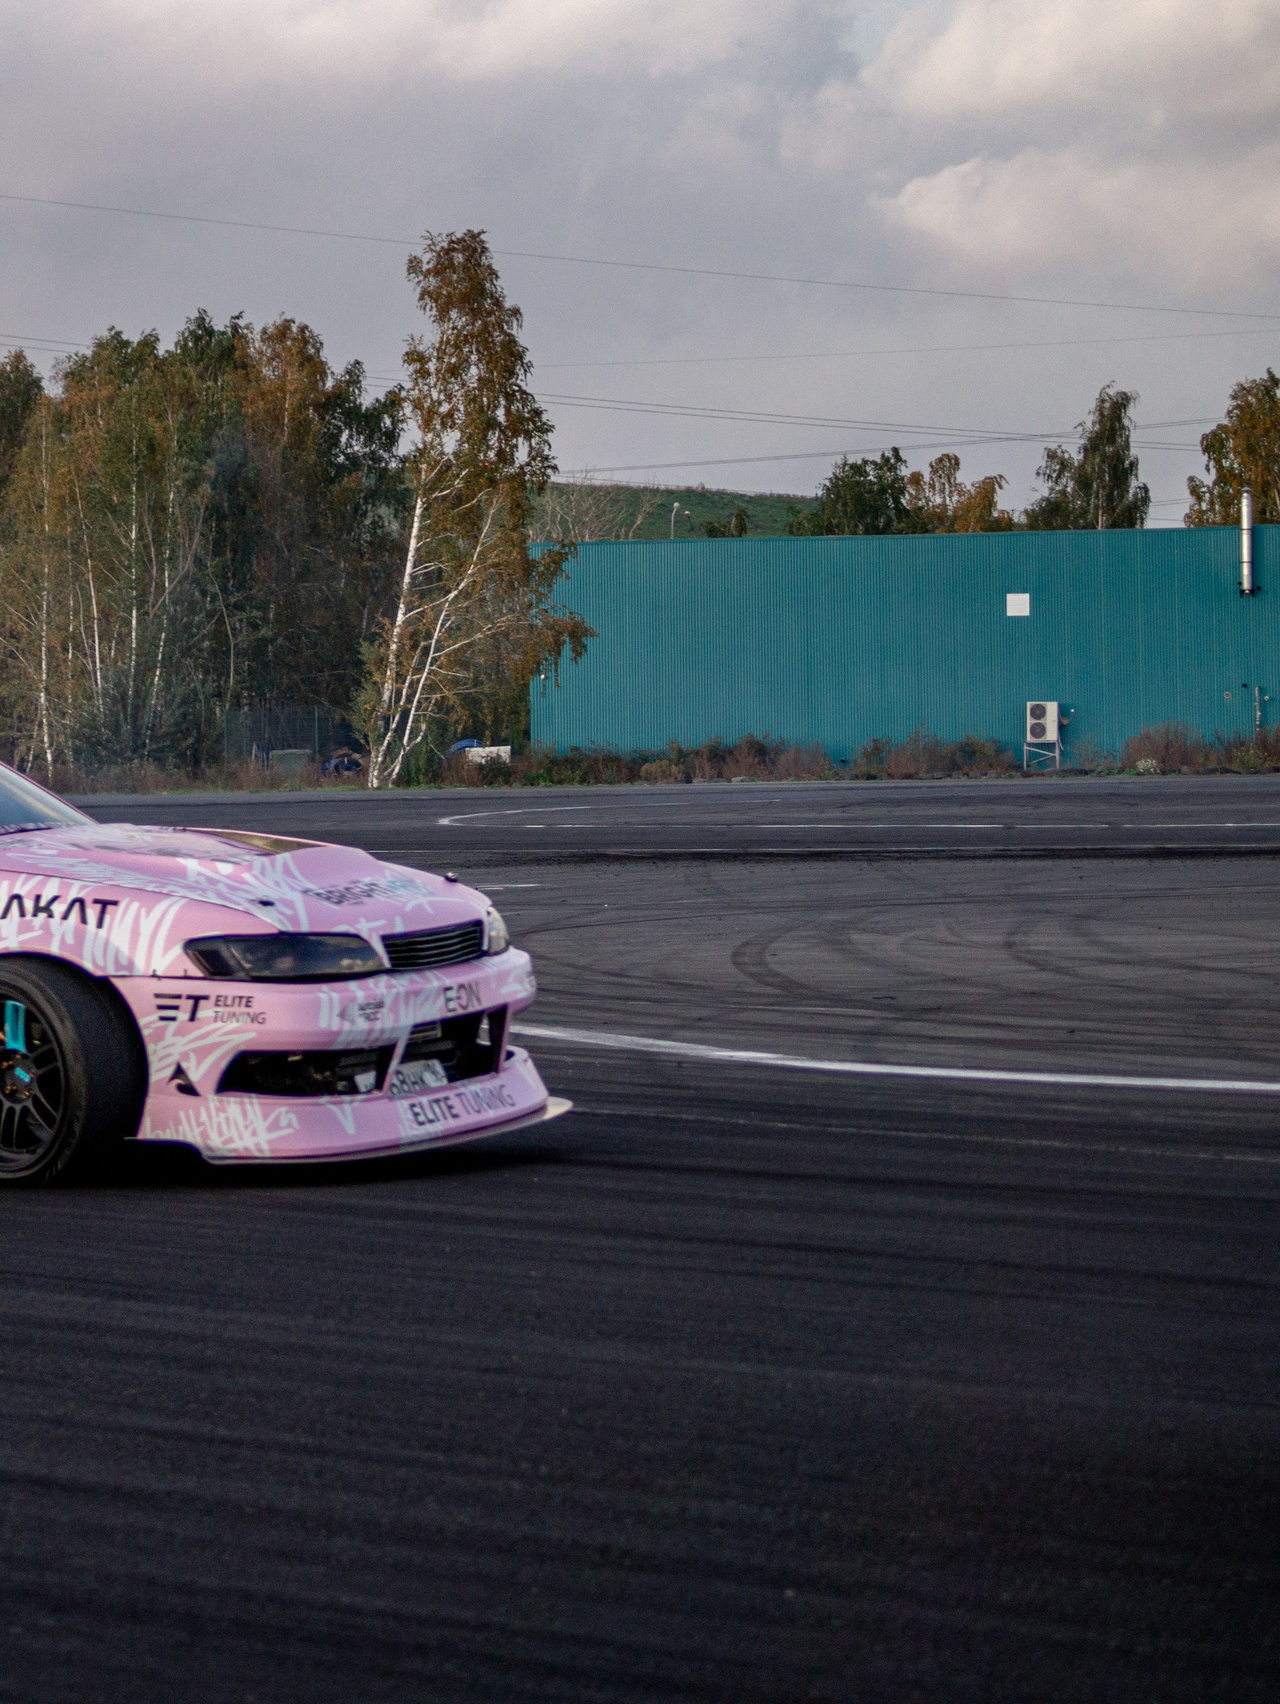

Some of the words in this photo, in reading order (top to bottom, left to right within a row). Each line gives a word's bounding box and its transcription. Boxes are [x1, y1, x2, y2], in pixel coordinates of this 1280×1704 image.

[214, 995, 253, 1008] ELITE
[214, 1010, 266, 1024] TUNING
[409, 1096, 460, 1126] ELITE
[454, 1084, 515, 1115] TUNING
